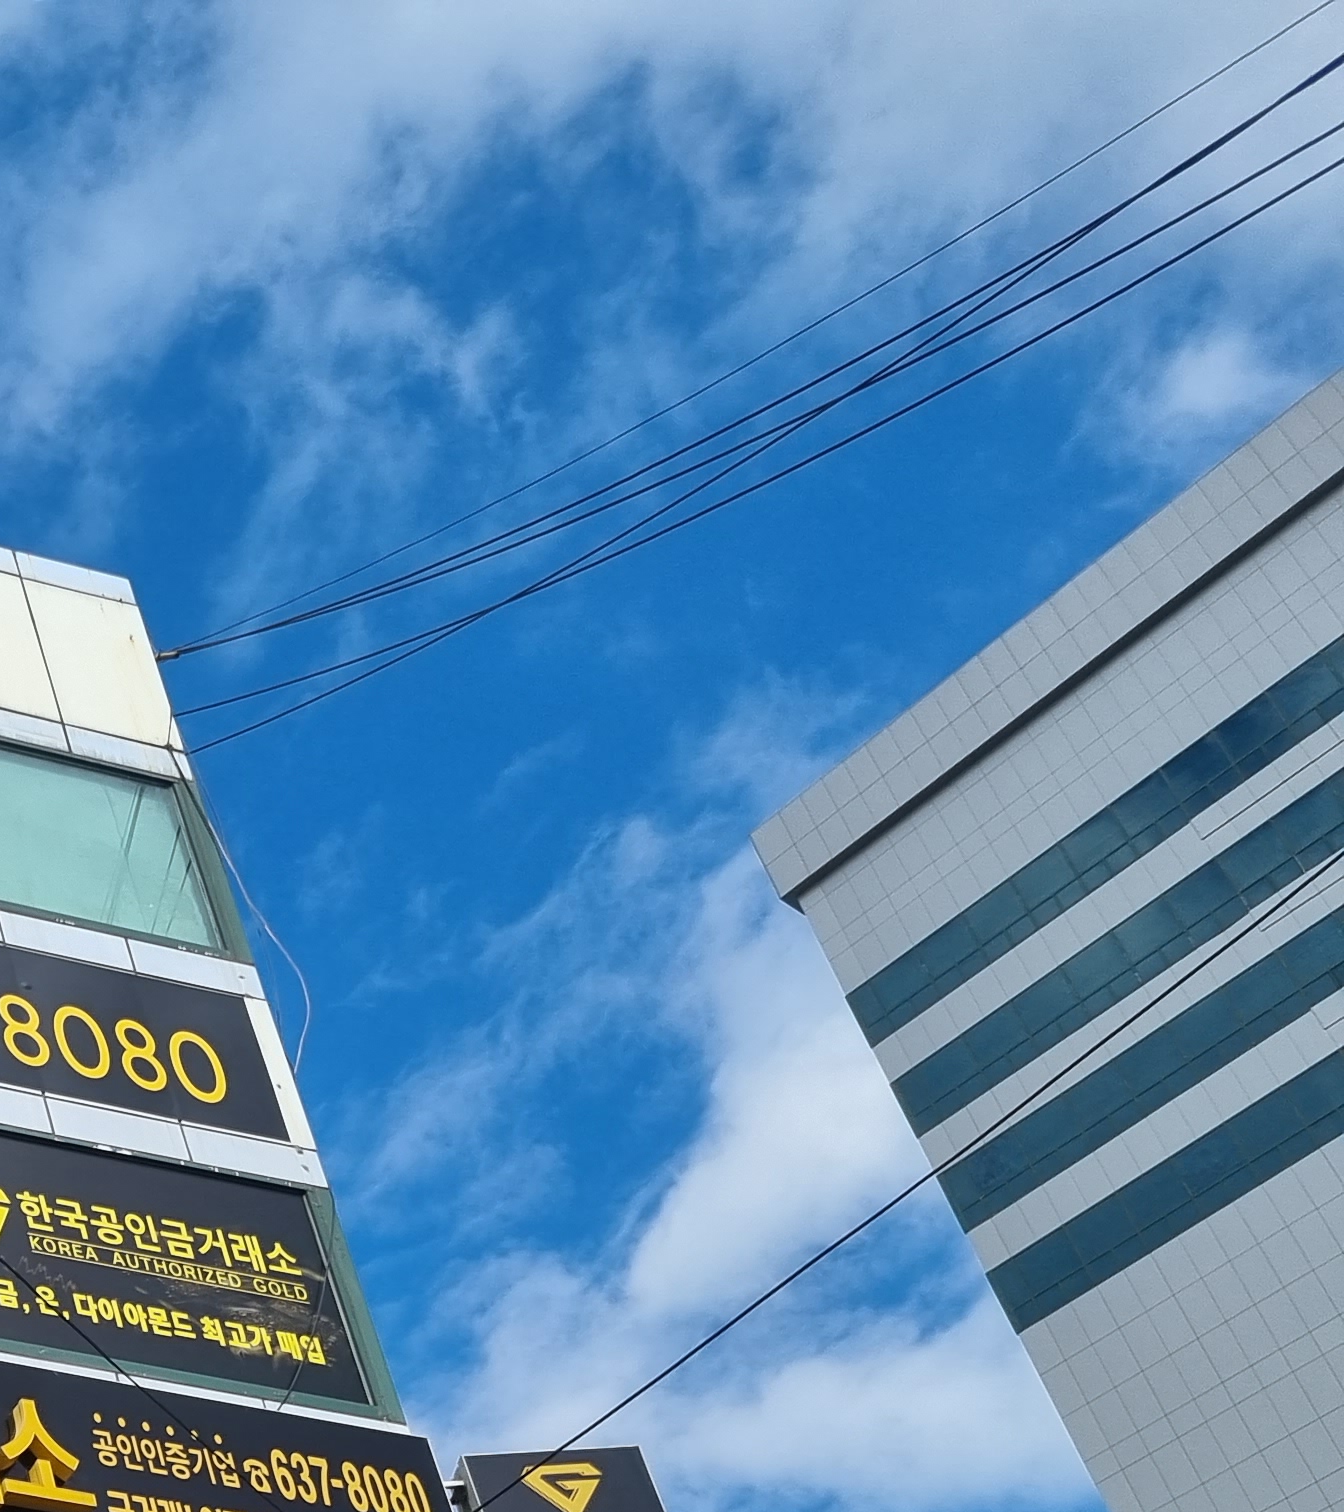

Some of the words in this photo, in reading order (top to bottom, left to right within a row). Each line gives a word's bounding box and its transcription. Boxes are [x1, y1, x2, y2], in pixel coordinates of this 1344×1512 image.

[16, 1191, 303, 1276] 한국공인금거래소
[30, 1235, 98, 1261] KOREA
[112, 1251, 242, 1289] AUTHORIZED
[253, 1278, 308, 1301] GOLD
[72, 1292, 197, 1339] 다이아몬드
[200, 1315, 273, 1356] 최고가
[277, 1330, 327, 1366] 매입
[92, 1427, 241, 1489] 공인인증기업
